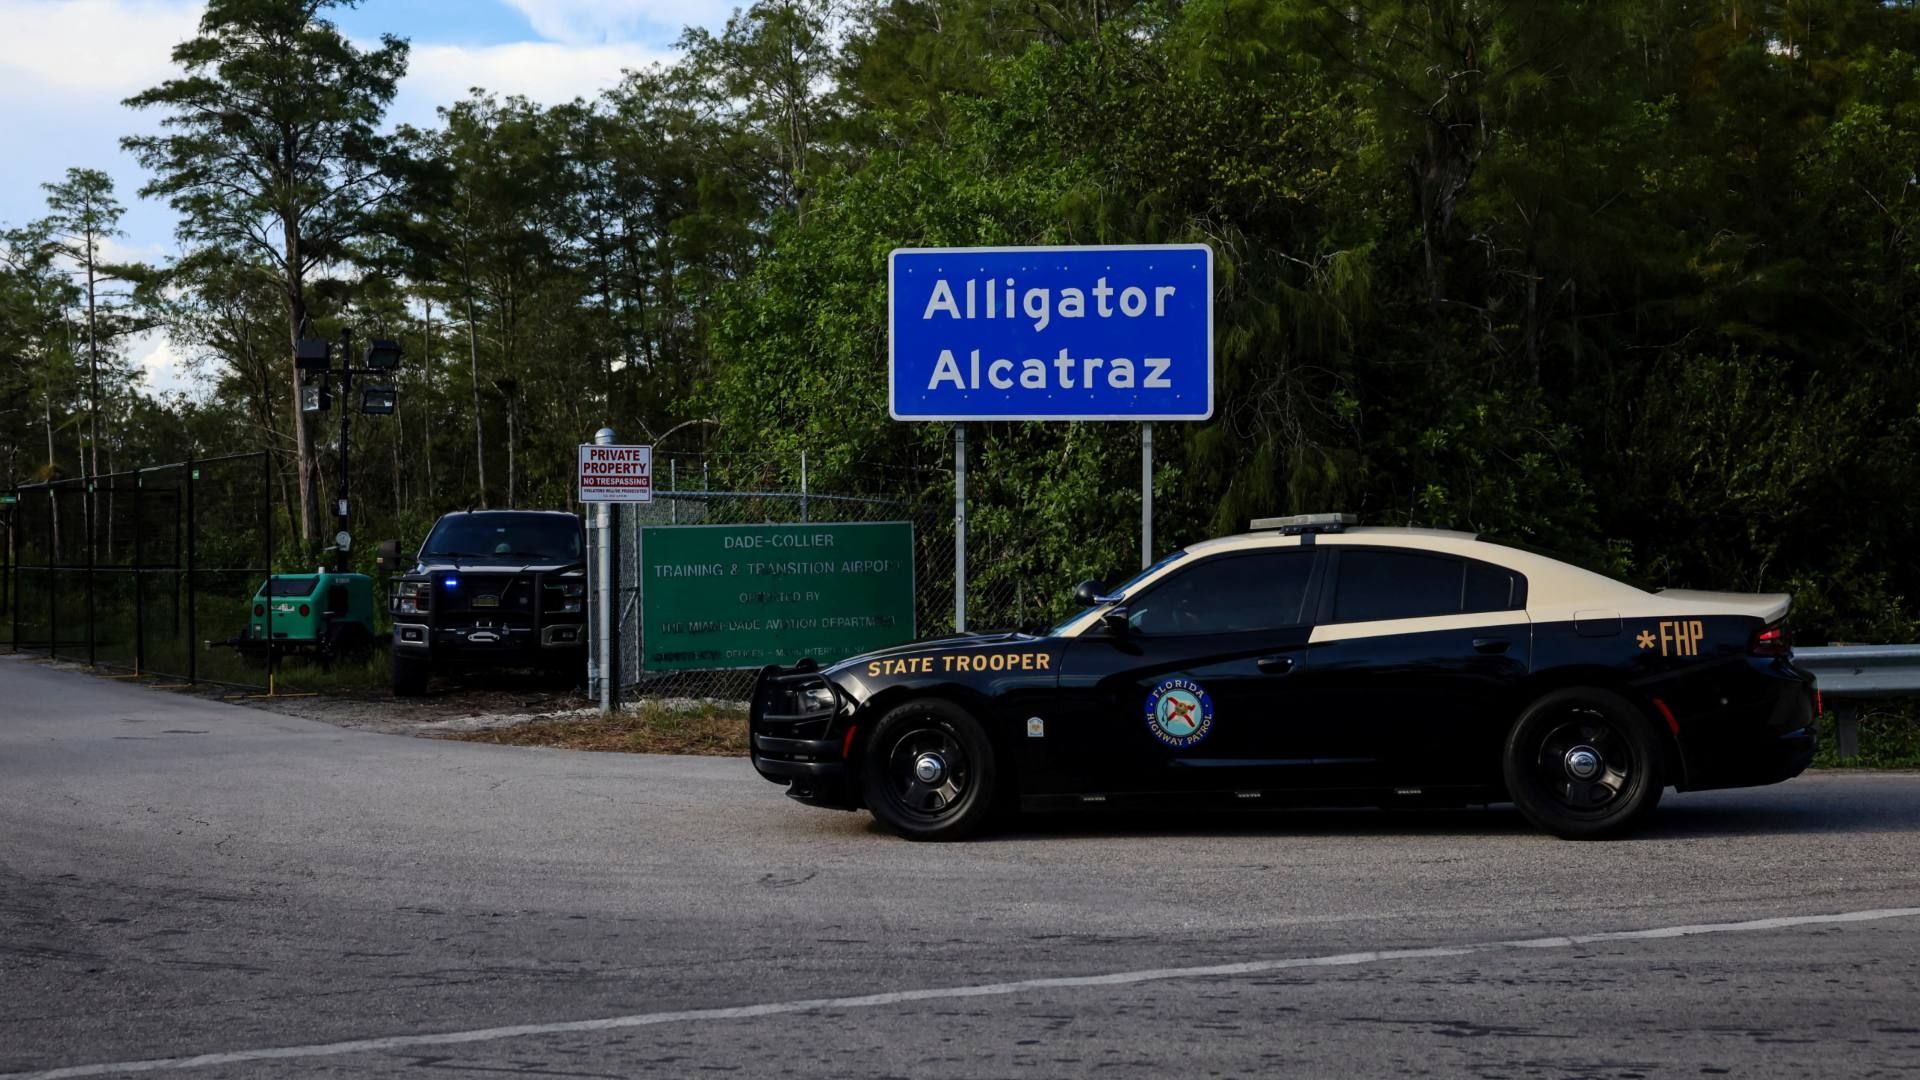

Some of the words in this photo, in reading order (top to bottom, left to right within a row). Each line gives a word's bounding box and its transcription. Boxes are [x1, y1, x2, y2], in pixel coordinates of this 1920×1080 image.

[923, 276, 1176, 332] Alligator
[927, 347, 1171, 390] Alcatraz
[591, 449, 640, 461] PRIVATE
[583, 462, 647, 474] PROPERTY
[583, 477, 594, 485] NO
[596, 477, 648, 486] TRESPASSING
[724, 534, 834, 549] DADE-COLLIER
[654, 563, 723, 577] TRAINING
[730, 563, 738, 576] &
[746, 561, 835, 576] TRANSITION
[739, 591, 801, 603] OPTED
[806, 591, 821, 601] BY
[822, 615, 896, 628] DEPARTMT
[868, 657, 934, 677] STATE
[942, 653, 1050, 672] TROOPER
[1152, 679, 1204, 699] FLORIDA
[1147, 713, 1184, 746] HIGHWAY
[1187, 713, 1212, 745] PATROL
